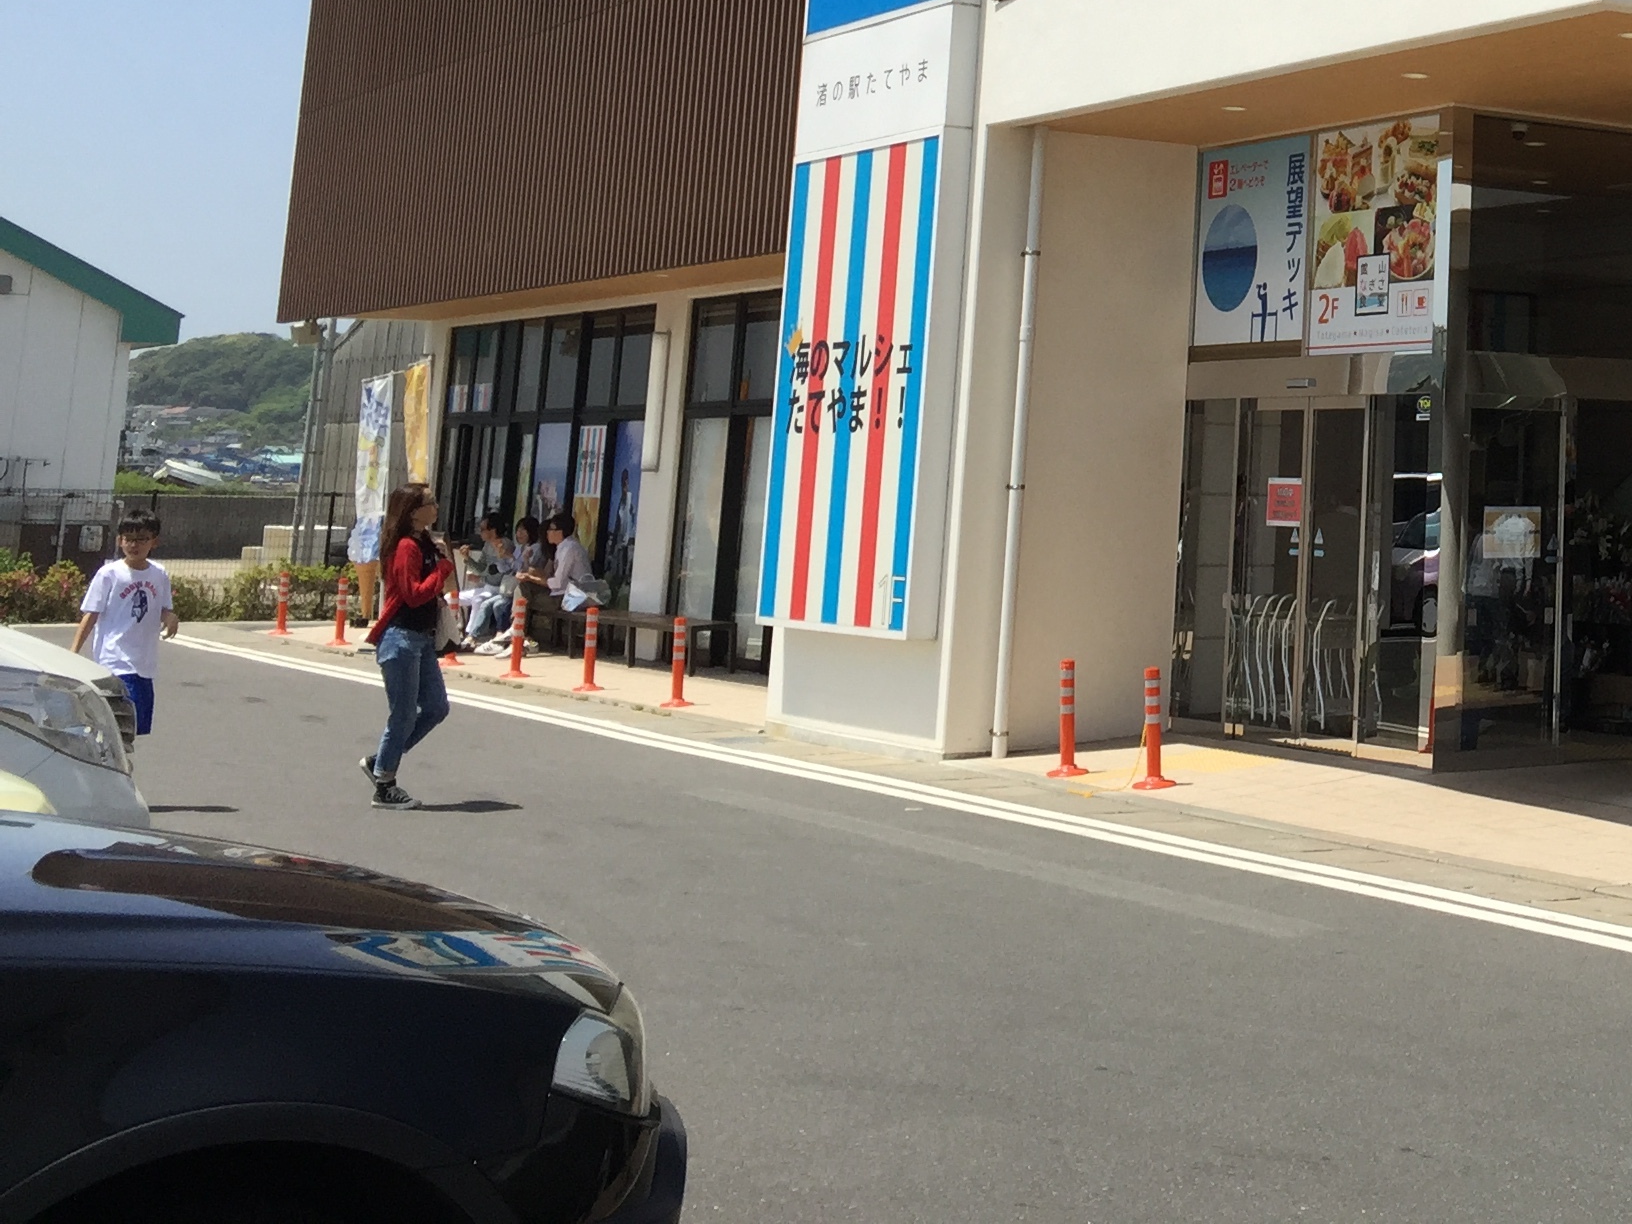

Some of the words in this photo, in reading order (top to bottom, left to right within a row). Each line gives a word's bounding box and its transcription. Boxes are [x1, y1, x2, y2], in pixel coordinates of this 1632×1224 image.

[815, 58, 929, 108] 渚の駅たてやま
[1282, 151, 1306, 322] 展望デッキ
[1317, 292, 1340, 325] 2F
[1359, 277, 1386, 292] なぎさ
[790, 334, 913, 384] 海のマルシェ
[878, 572, 907, 627] 1F
